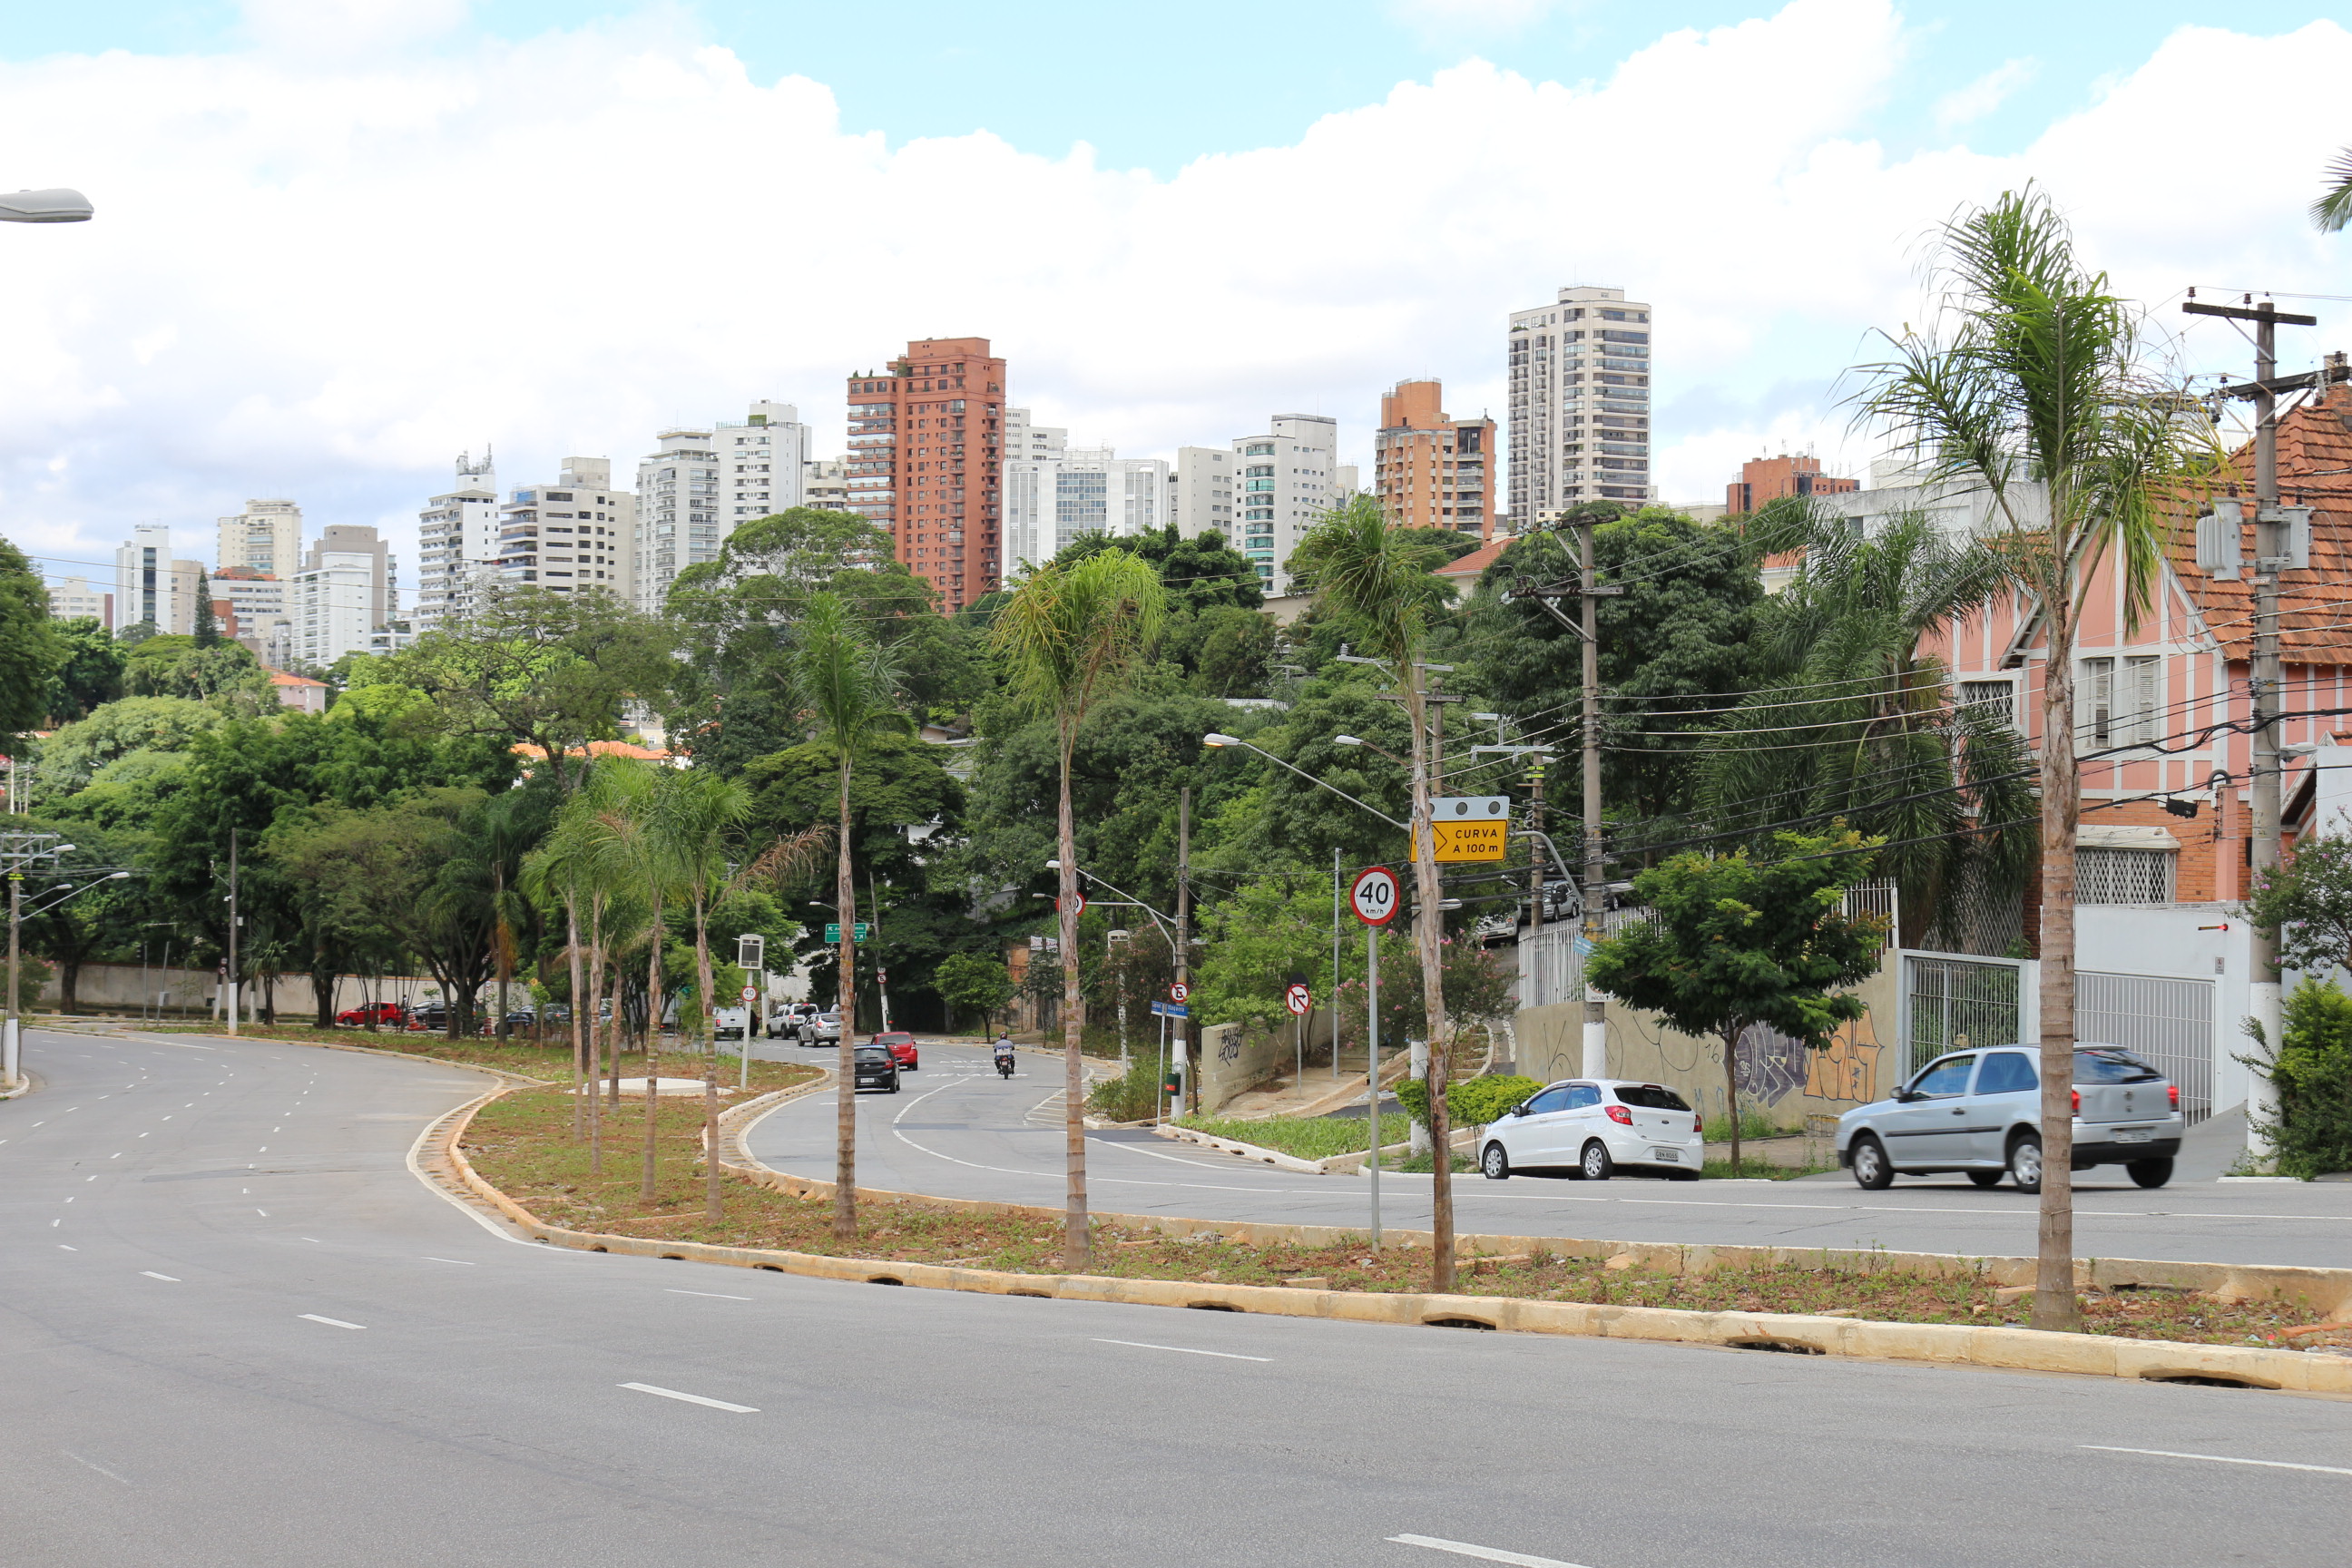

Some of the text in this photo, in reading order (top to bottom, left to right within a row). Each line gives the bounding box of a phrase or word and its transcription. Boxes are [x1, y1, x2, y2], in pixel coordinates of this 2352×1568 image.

[1455, 828, 1497, 838] CURVA
[1453, 844, 1461, 853] A
[1466, 844, 1485, 853] 100
[1359, 881, 1389, 905] 40
